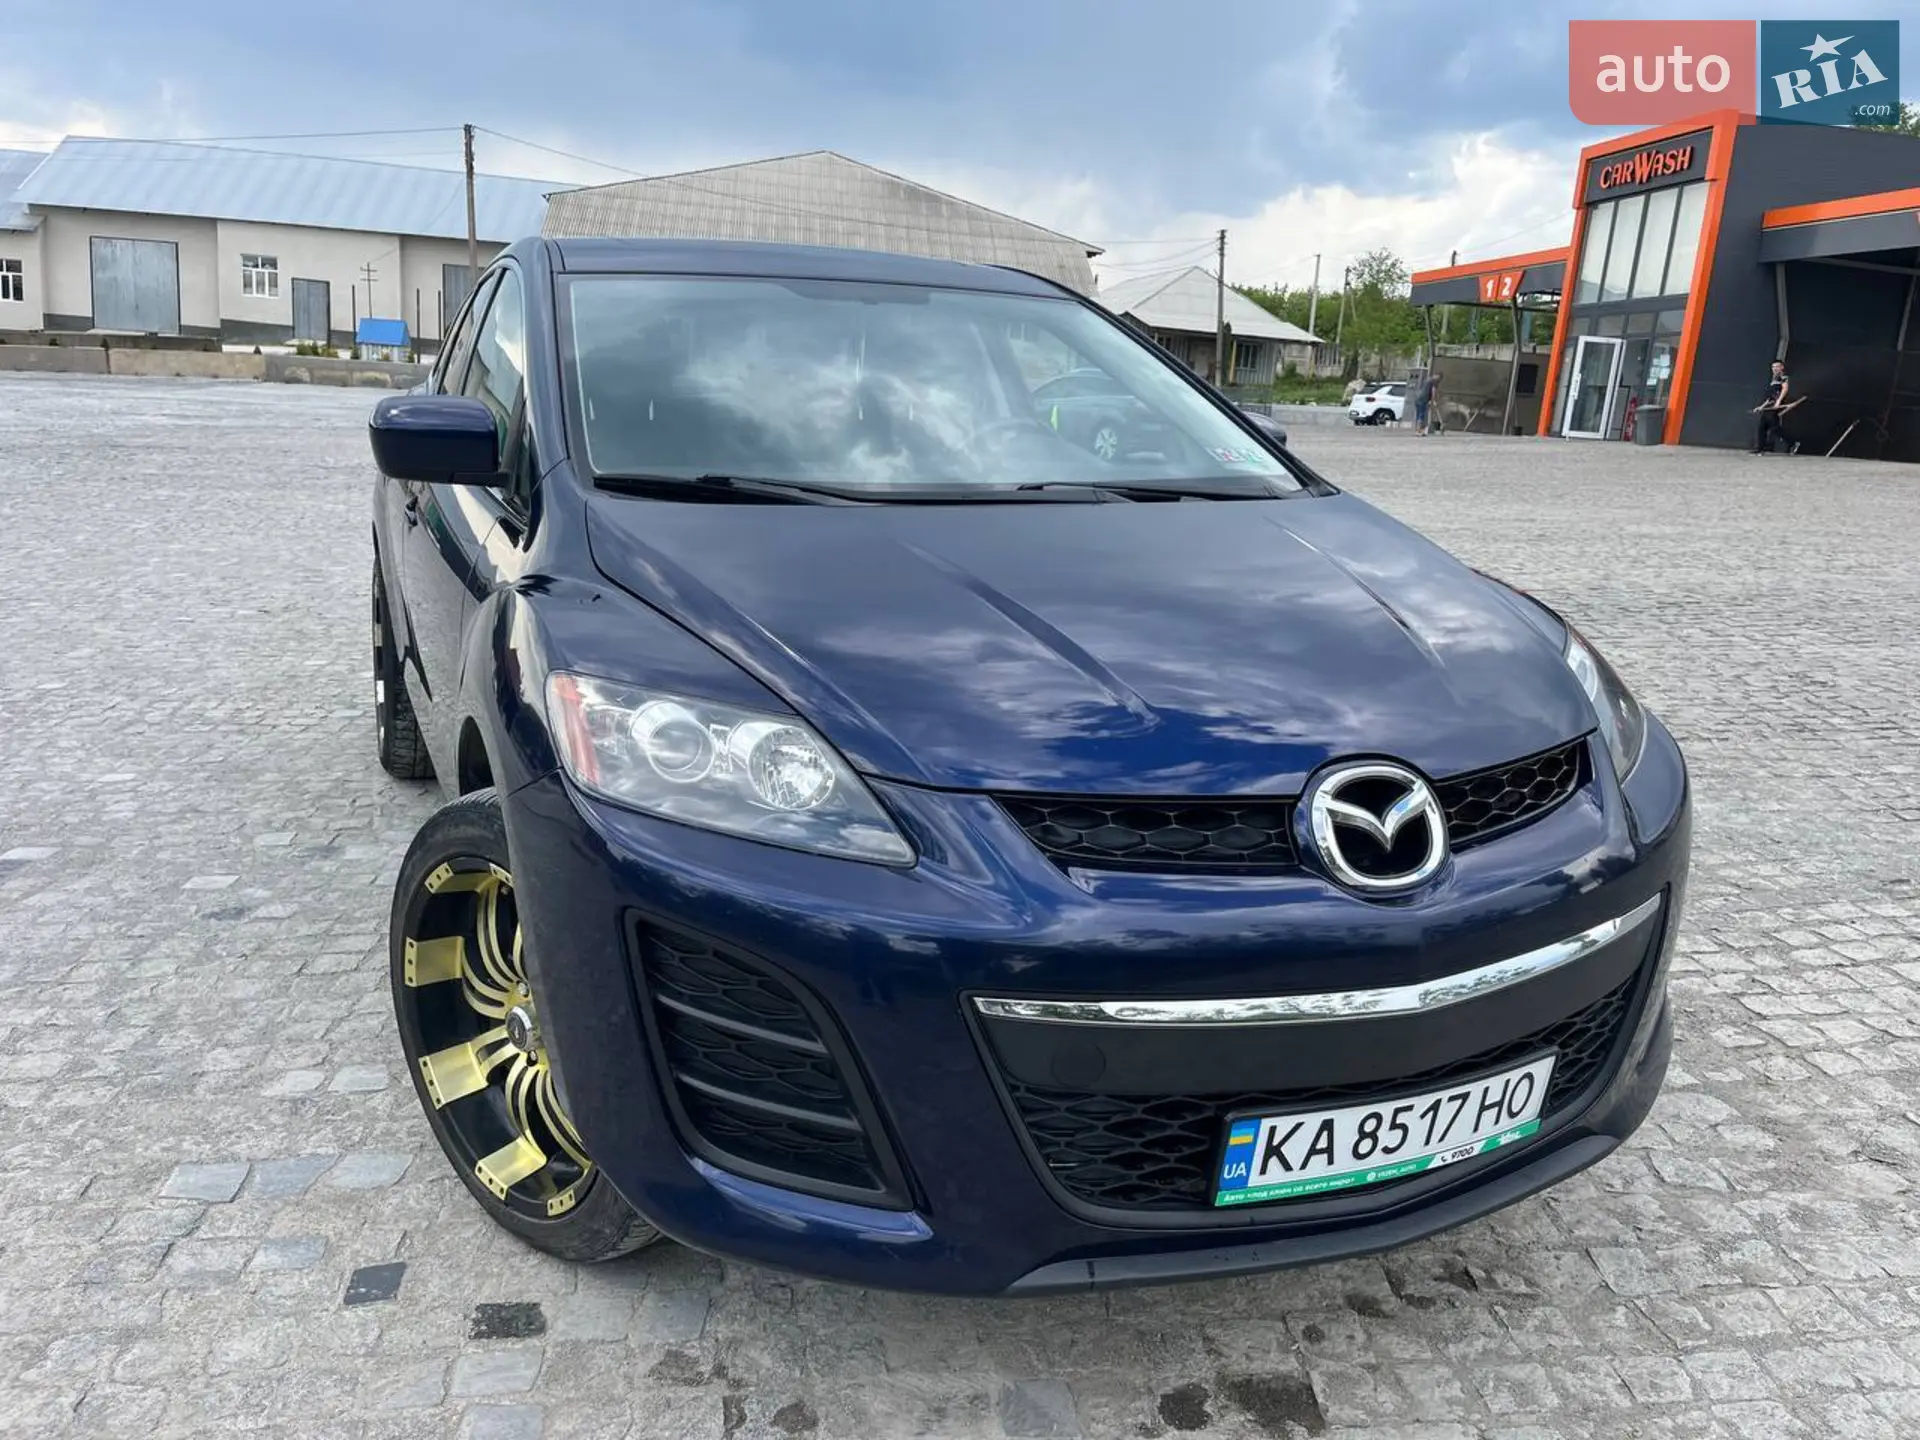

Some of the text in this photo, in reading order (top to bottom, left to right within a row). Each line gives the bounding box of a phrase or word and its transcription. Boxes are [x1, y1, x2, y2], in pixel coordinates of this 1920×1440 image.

[1486, 276, 1512, 298] 1 2
[1259, 1071, 1535, 1176] KA 8517 HO
[1223, 1162, 1247, 1179] UA
